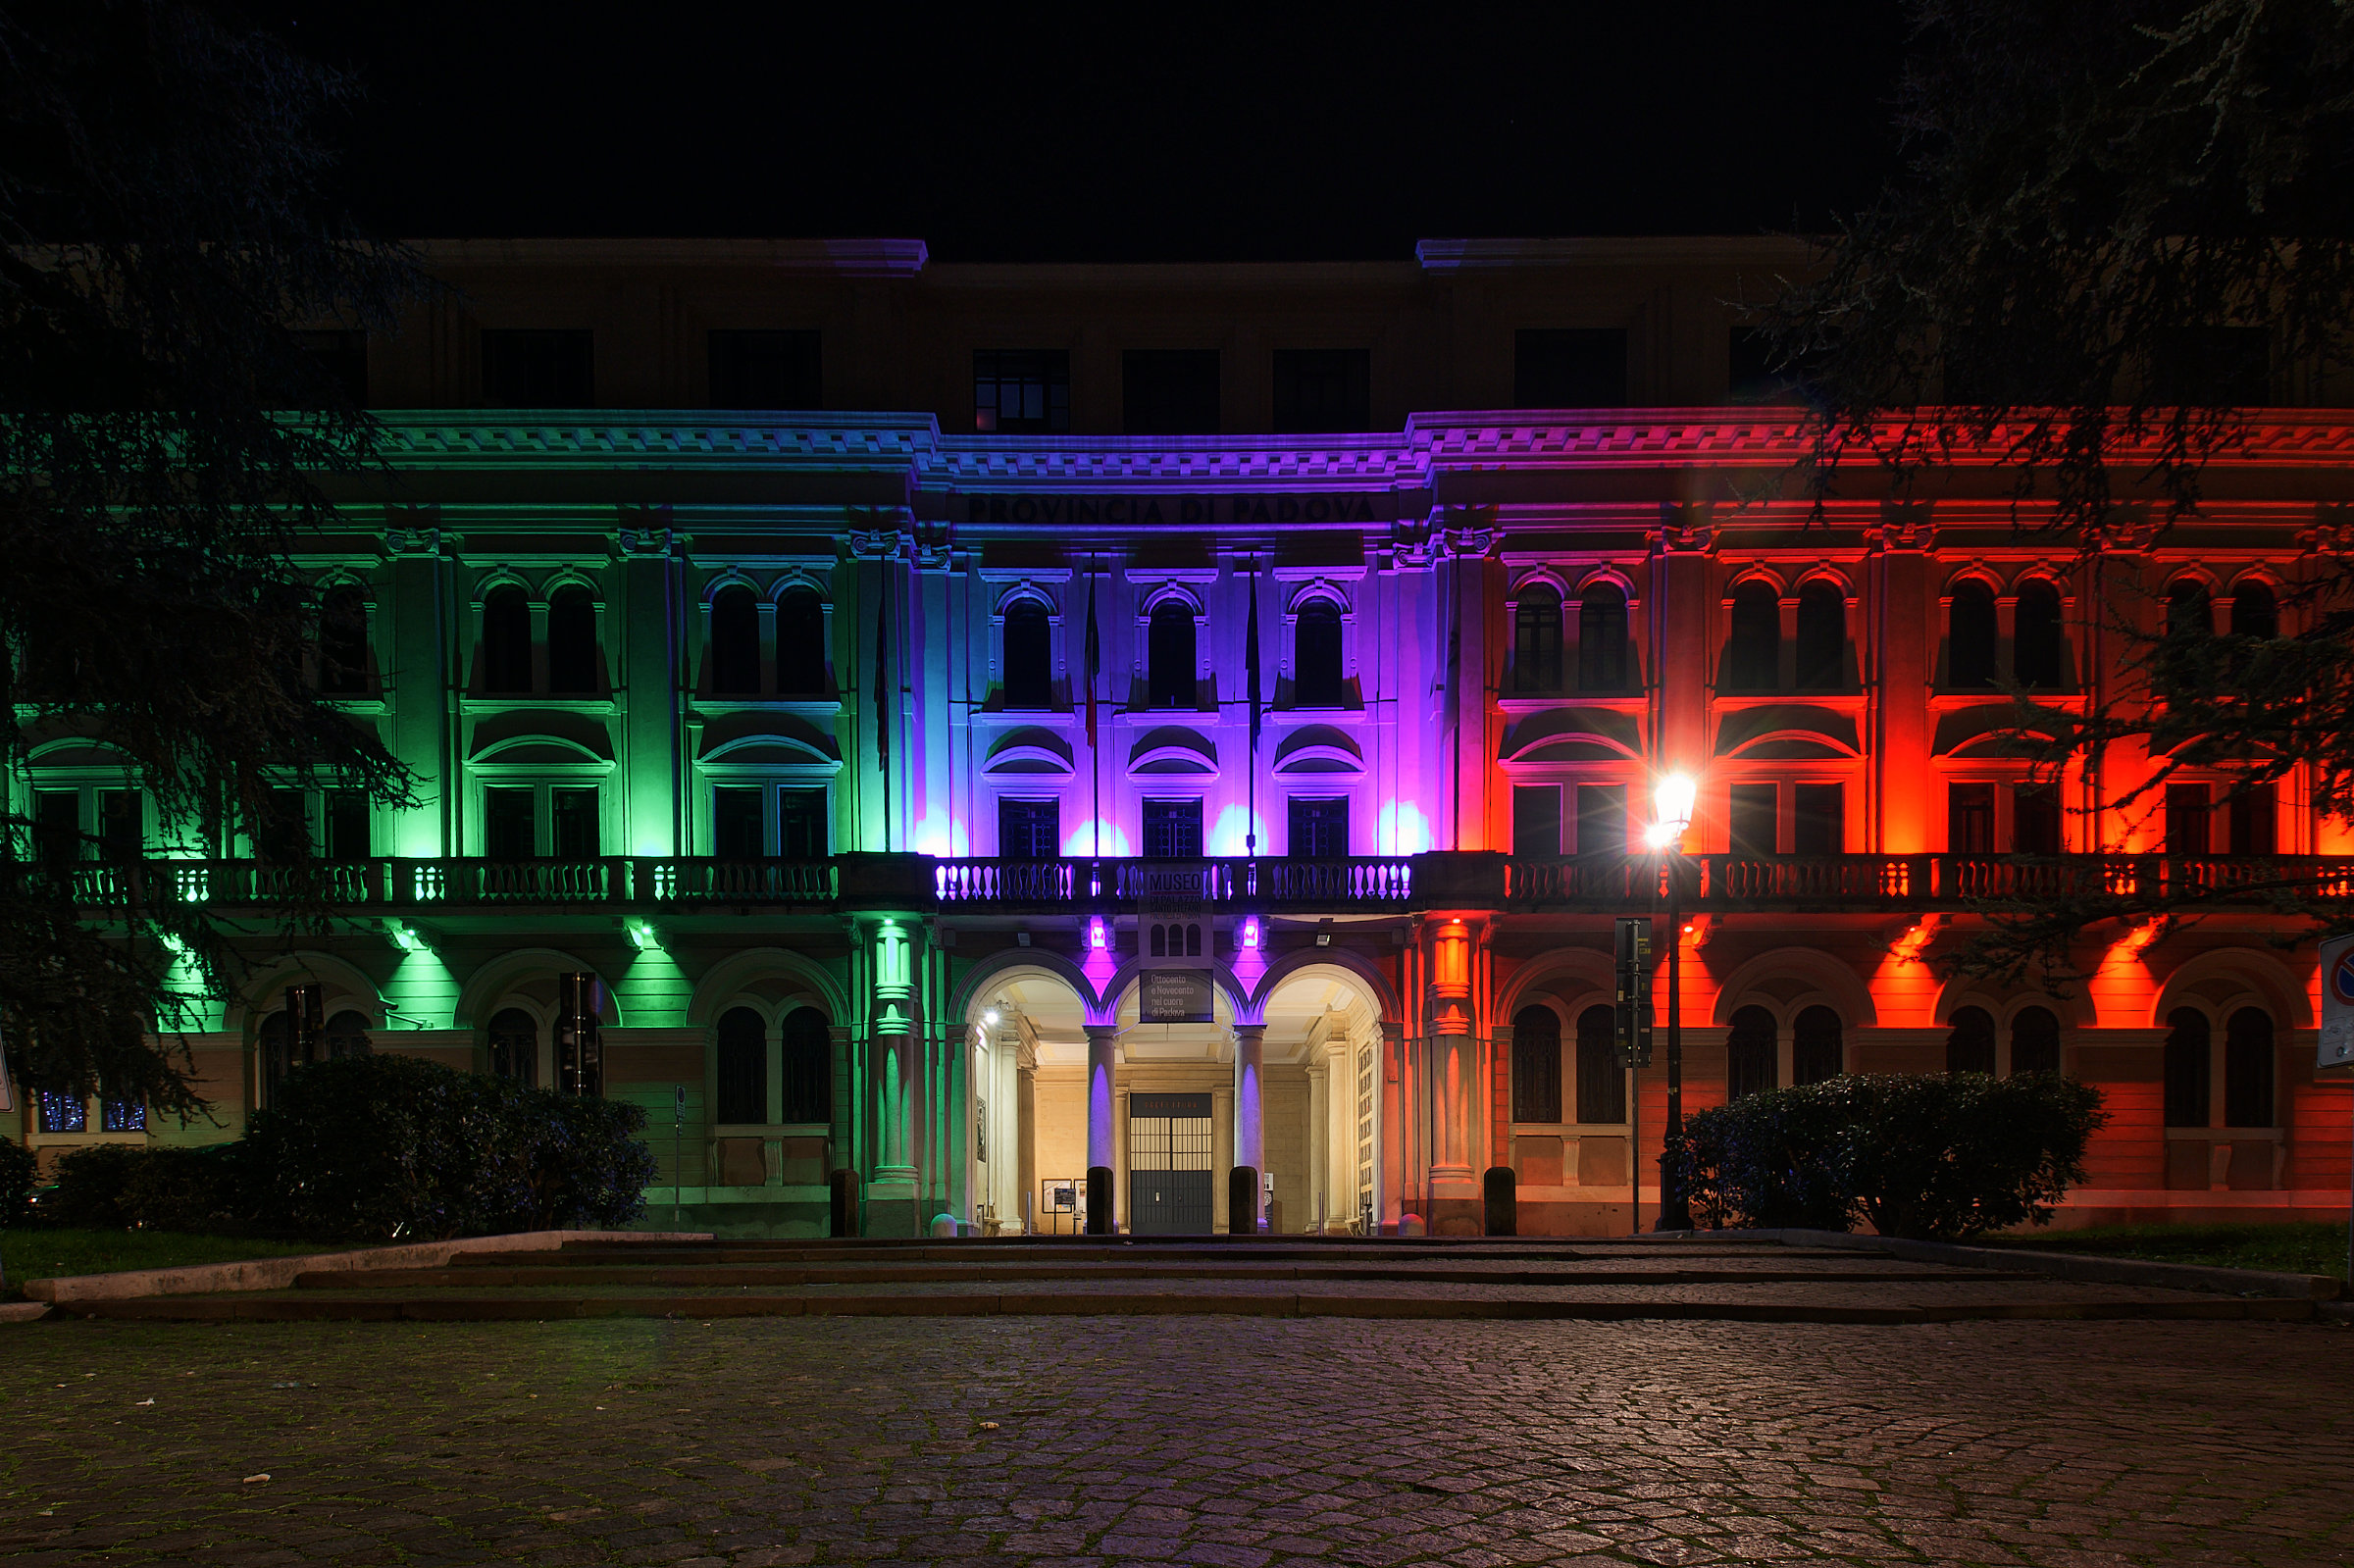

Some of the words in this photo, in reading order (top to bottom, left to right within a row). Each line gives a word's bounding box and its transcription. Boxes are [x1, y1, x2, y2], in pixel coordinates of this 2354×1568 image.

[968, 498, 1165, 524] PROVINCIA
[1181, 498, 1214, 523] DI
[1233, 496, 1376, 523] PADOVA
[1150, 874, 1201, 890] MUSEO
[1150, 895, 1158, 904] DI
[1160, 895, 1201, 904] PALAZZO
[1151, 975, 1186, 984] Ottocento
[1157, 986, 1194, 994] Novecento
[1151, 1007, 1158, 1016] di
[1159, 1007, 1185, 1016] Padova
